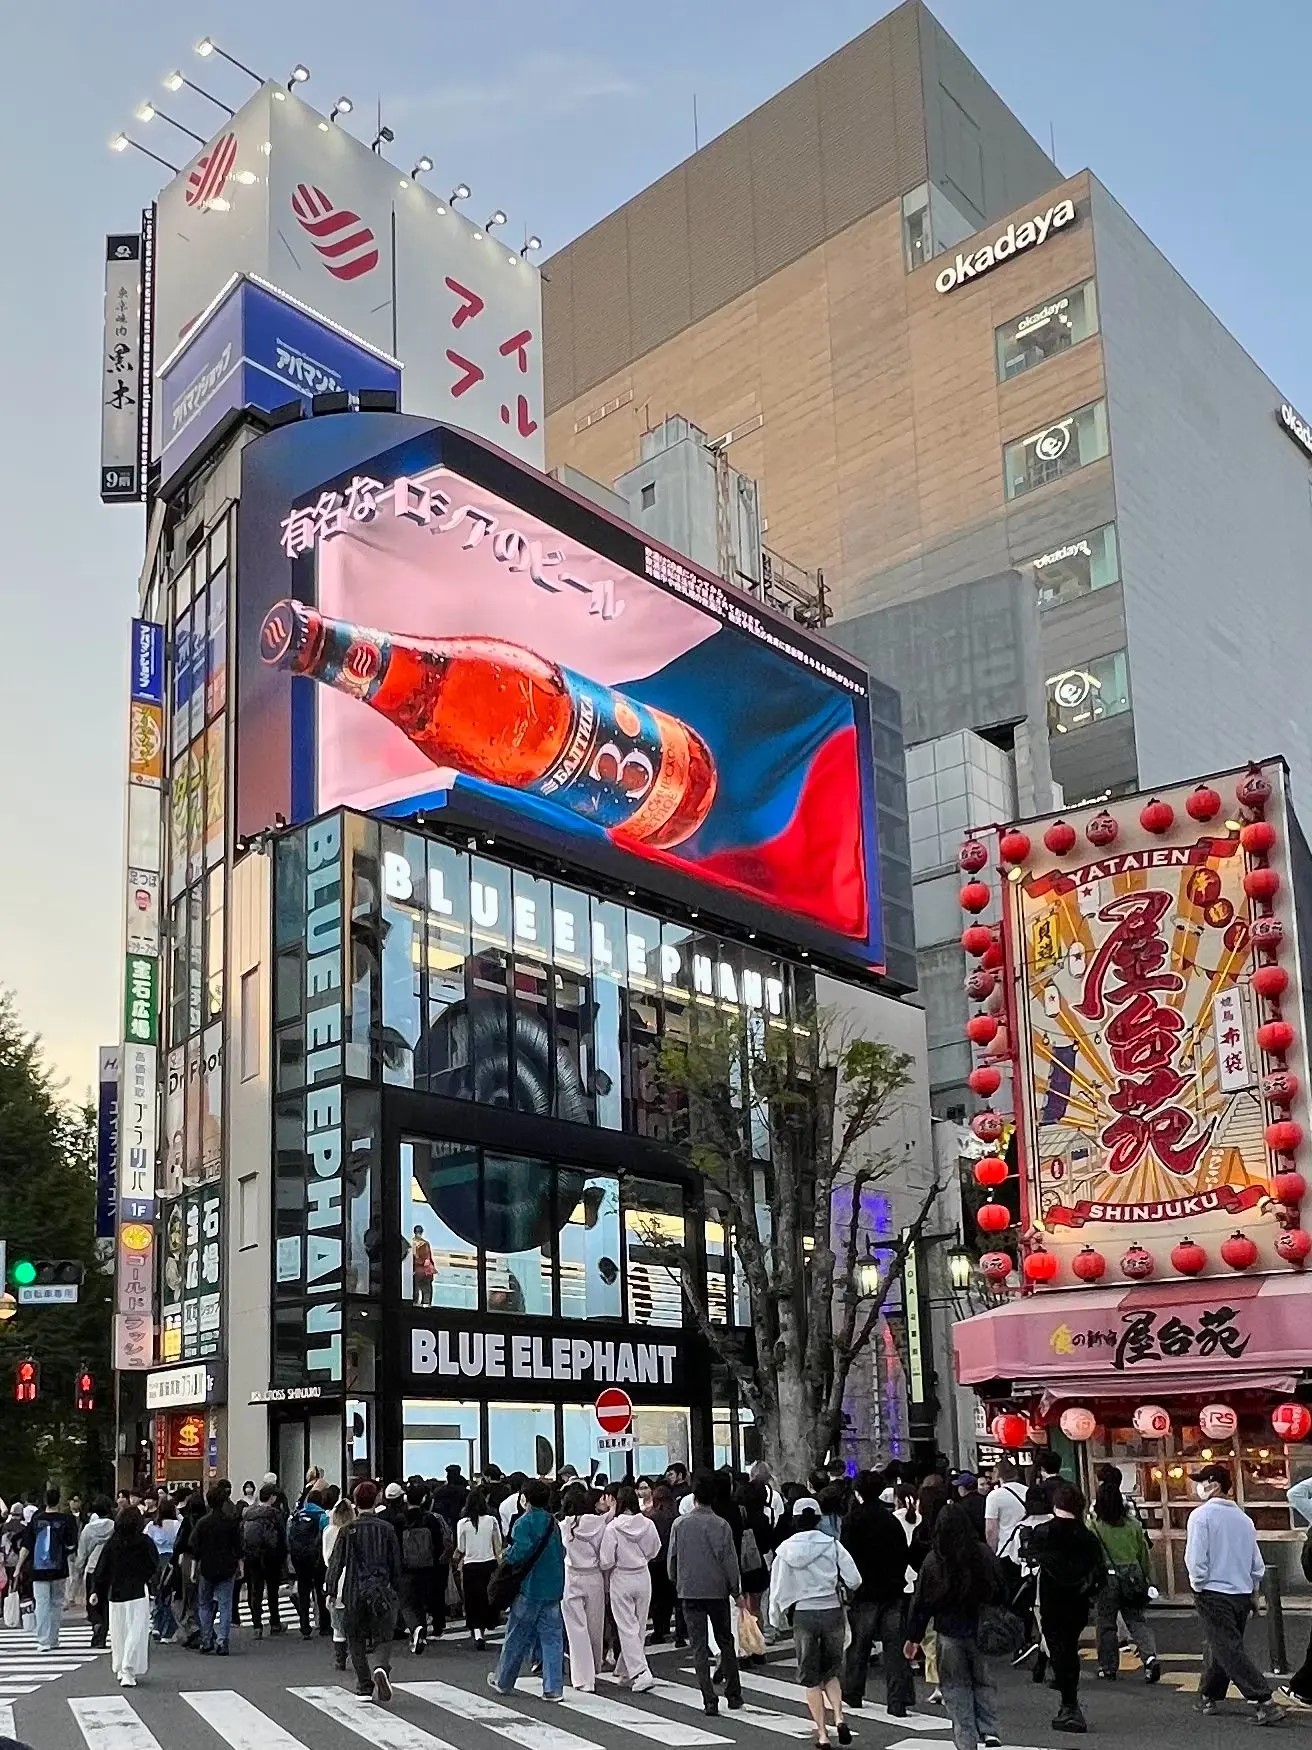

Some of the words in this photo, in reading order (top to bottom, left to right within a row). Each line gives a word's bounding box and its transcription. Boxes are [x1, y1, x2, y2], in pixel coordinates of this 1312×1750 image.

[935, 198, 1077, 294] okadaya
[1017, 297, 1070, 331] okadaya
[105, 342, 136, 410] 黒木
[280, 475, 626, 621] 有名なロシアのビール
[552, 693, 594, 786] БАЛТИКА
[589, 742, 654, 800] 3
[1067, 849, 1192, 888] YATAIEN
[131, 960, 152, 1039] 宝石広場
[1072, 890, 1217, 1175] 屋台苑
[131, 1202, 147, 1217] 1F
[1088, 1191, 1220, 1222] SHINJUKU
[411, 1328, 505, 1377] BLUE
[511, 1335, 677, 1384] ELEPHANT
